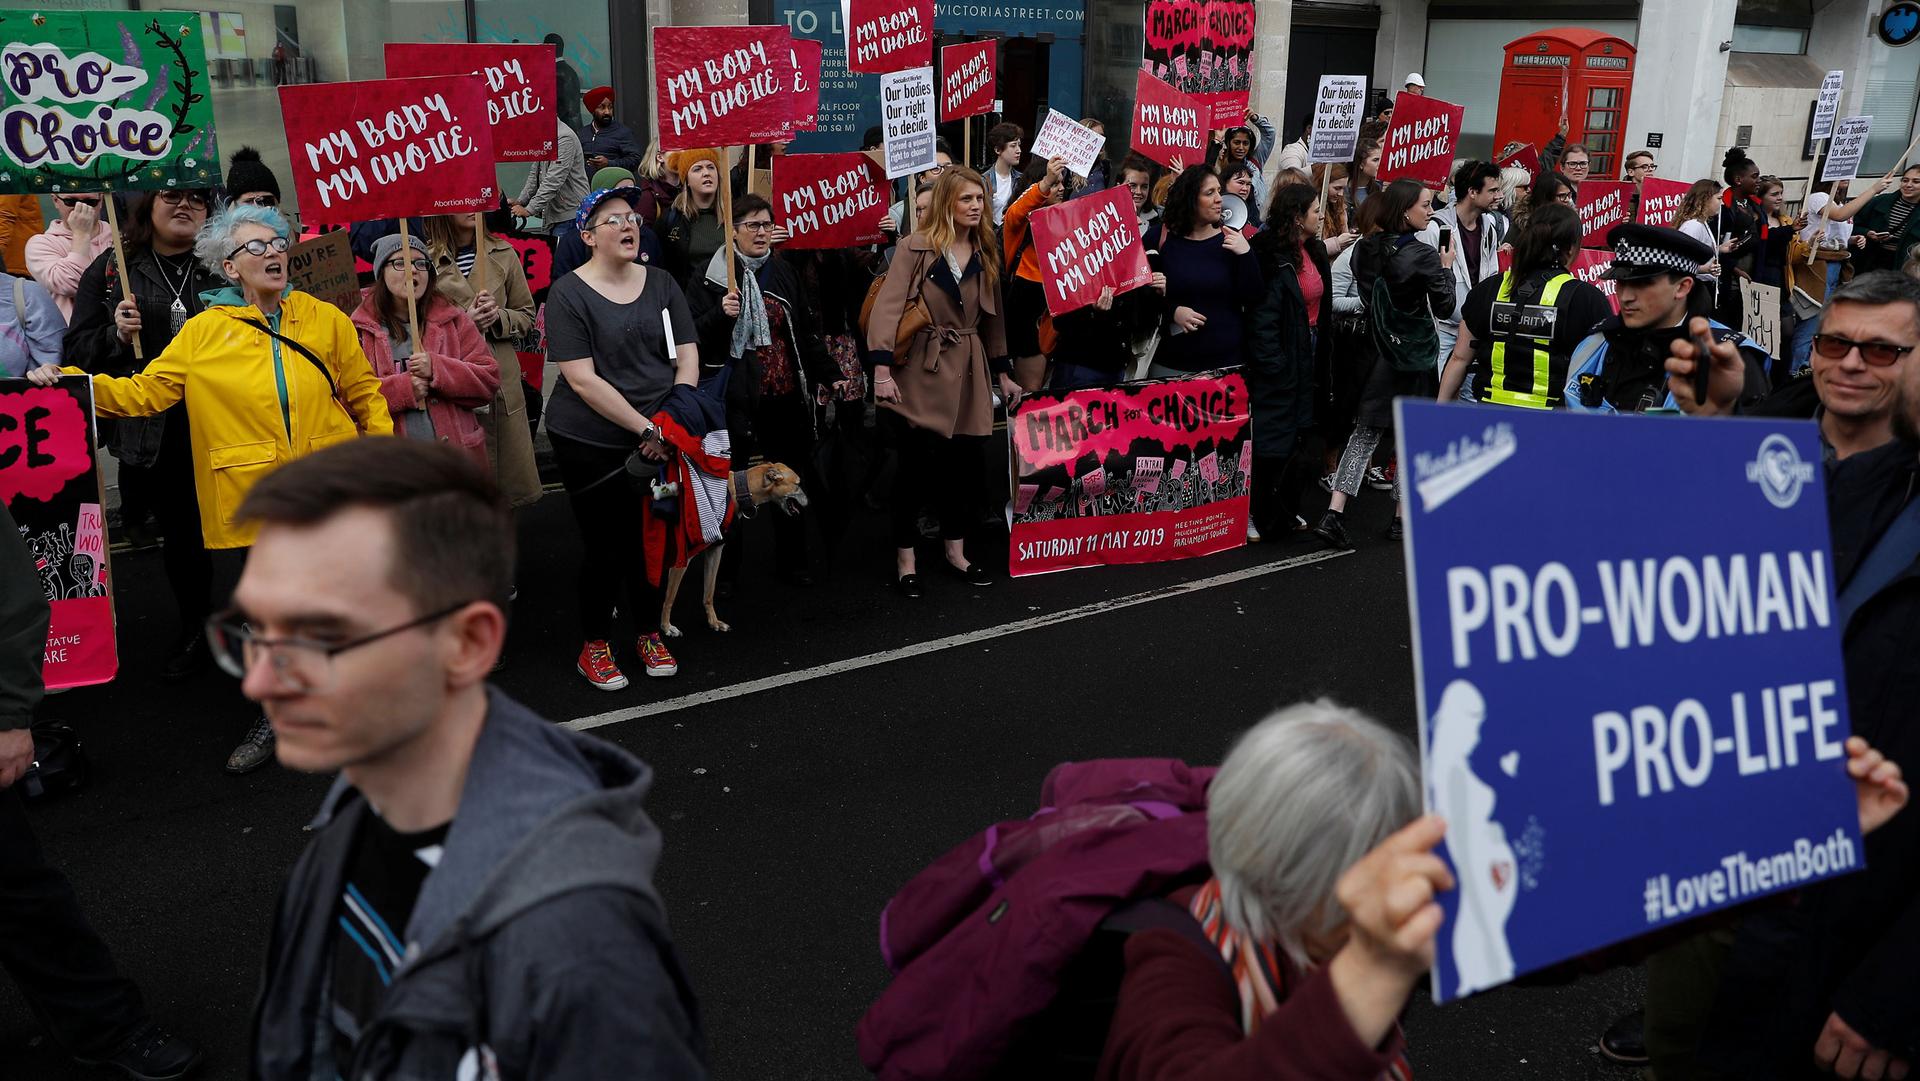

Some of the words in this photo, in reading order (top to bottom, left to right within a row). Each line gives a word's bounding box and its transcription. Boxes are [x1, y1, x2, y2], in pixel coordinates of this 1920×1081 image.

[856, 21, 877, 43] MY
[879, 6, 921, 33] BODY.
[1153, 8, 1197, 40] MARCH
[1209, 10, 1248, 38] CHOICE
[857, 41, 879, 64] MY
[881, 25, 928, 54] CHOICE.
[667, 67, 703, 104] MY
[704, 40, 771, 85] BODY.
[947, 69, 961, 93] MY
[961, 49, 988, 79] BODY.
[1516, 56, 1569, 66] TELEPHONE
[1587, 57, 1625, 68] TELEPHONE
[885, 86, 901, 102] Our
[904, 82, 931, 99] bodies
[948, 89, 962, 112] MY
[963, 66, 992, 99] CHOICE.
[1322, 86, 1337, 99] Our
[1338, 86, 1363, 100] bodies
[671, 99, 708, 136] MY
[710, 68, 783, 118] CHOICE.
[833, 103, 860, 111] FLOOR
[886, 104, 902, 120] Our
[905, 99, 926, 119] right
[1319, 101, 1335, 114] Our
[1336, 101, 1356, 117] right
[888, 123, 898, 138] to
[900, 116, 928, 135] decide
[1140, 104, 1160, 124] MY
[1162, 104, 1199, 128] BODY.
[1317, 117, 1327, 129] to
[1329, 116, 1354, 129] decide
[4, 107, 168, 166] Choice
[305, 129, 358, 172] MY
[356, 93, 458, 148] BODY.
[1140, 126, 1159, 145] MY
[1162, 127, 1202, 149] CHOICE.
[1391, 123, 1411, 148] MY
[1414, 113, 1450, 140] BODY.
[1834, 136, 1846, 146] Our
[1847, 135, 1862, 148] right
[1837, 125, 1849, 135] Our
[1850, 124, 1868, 135] bodies
[529, 149, 547, 157] Rights
[1387, 147, 1407, 171] MY
[1410, 135, 1450, 164] CHOICE.
[1831, 148, 1839, 157] to
[1840, 146, 1859, 157] decide
[316, 165, 368, 208] MY
[370, 125, 479, 185] CHOICE.
[783, 185, 816, 214] MY
[817, 162, 874, 200] BODY.
[434, 197, 464, 207] Abortion
[465, 197, 486, 207] Rights
[785, 212, 819, 238] MY
[822, 184, 882, 226] CHOICE.
[1645, 196, 1663, 212] MY
[1644, 210, 1662, 226] MY
[1047, 237, 1078, 274] MY
[1073, 201, 1123, 250] BODY.
[1055, 266, 1086, 301] MY
[1083, 223, 1135, 277] CHOICE.
[1496, 313, 1547, 327] SEURITY
[1025, 400, 1120, 452] MARCH
[1124, 407, 1143, 424] for
[1147, 385, 1237, 432] CHOICE
[1137, 458, 1163, 468] CENTRAL
[1175, 518, 1203, 529] MEETING
[1205, 512, 1227, 523] POINT:
[1018, 534, 1082, 562] SATURDAY
[1085, 535, 1099, 552] 11
[1100, 530, 1130, 550] MAY
[1133, 527, 1164, 548] 2019
[1173, 532, 1209, 548] PARLIAMENT
[1209, 526, 1229, 539] SQUARE
[1446, 549, 1831, 668] PRO-WOMAN
[1592, 679, 1844, 806] PRO-LIFE
[1642, 829, 1855, 924] #LoveThemBoth
